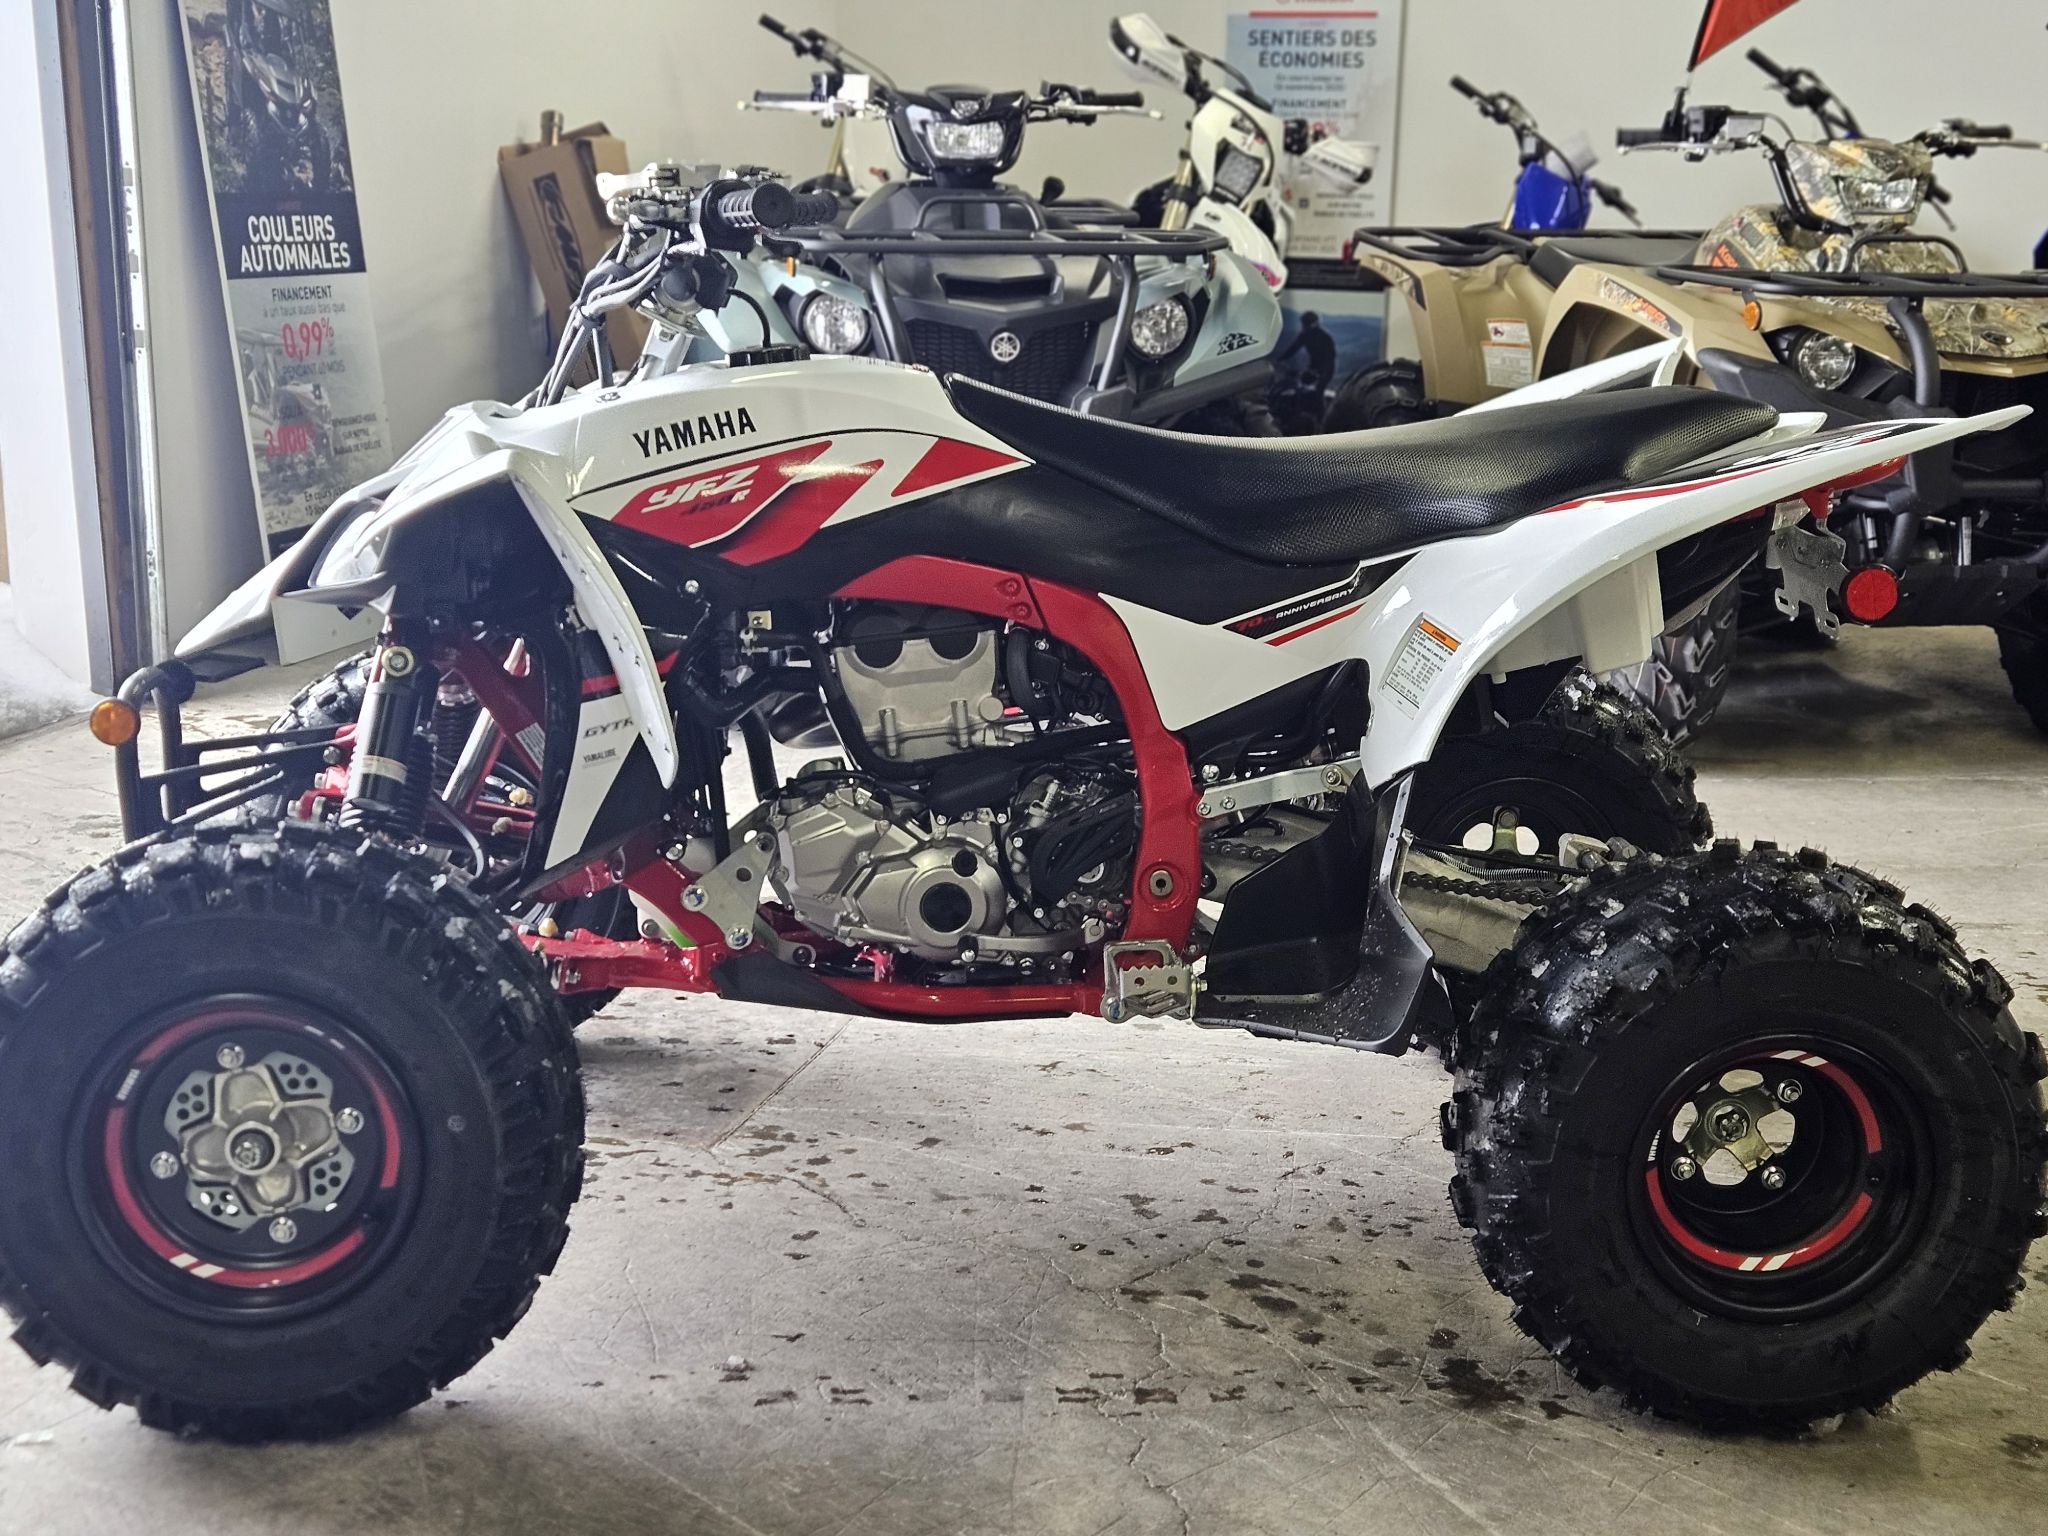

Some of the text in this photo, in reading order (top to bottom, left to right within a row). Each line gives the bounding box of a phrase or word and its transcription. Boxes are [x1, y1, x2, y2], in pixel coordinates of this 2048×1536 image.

[1247, 29, 1377, 47] SENTIERS DES
[1258, 46, 1365, 68] ÉCONOMIES
[247, 214, 336, 243] COULEURS
[241, 241, 351, 273] AUTOMNALES
[271, 285, 333, 303] FINANCEMENT
[633, 406, 757, 458] YAMAHA
[641, 465, 760, 514] YFZ
[1275, 587, 1355, 619] ANNIVERSARY
